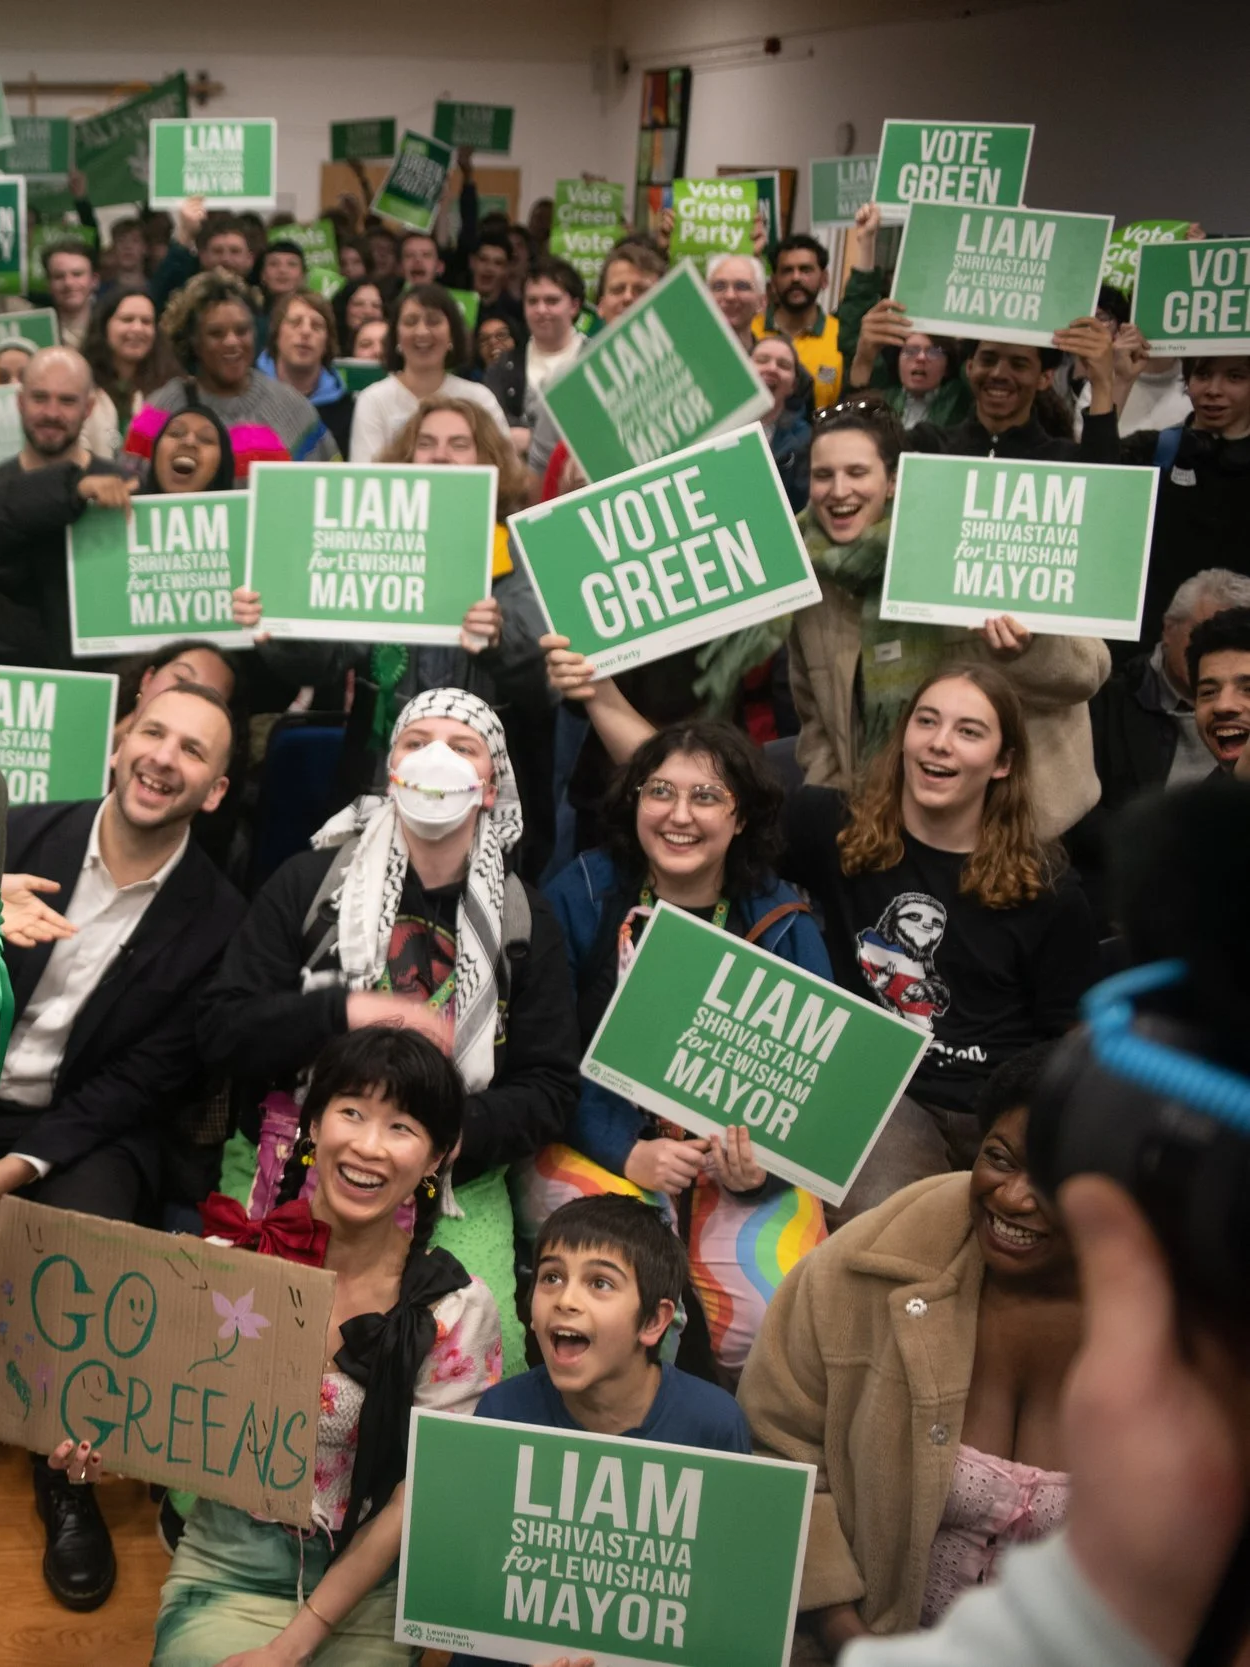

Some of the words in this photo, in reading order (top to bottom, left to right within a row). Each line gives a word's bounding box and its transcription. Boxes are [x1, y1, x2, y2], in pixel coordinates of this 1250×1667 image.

[183, 125, 245, 151] LIAM
[920, 129, 993, 166] VOTE
[182, 171, 245, 194] MAYOR
[566, 184, 613, 205] Vote
[688, 181, 744, 200] Vote
[897, 163, 1002, 205] GREEN
[557, 203, 617, 225] Green
[678, 197, 751, 222] Green
[563, 231, 615, 252] Vote
[680, 221, 744, 250] Party
[955, 213, 1057, 261] LIAM
[1123, 224, 1175, 243] Vote
[946, 268, 972, 287] for
[971, 272, 1046, 293] LEWISHAM
[953, 253, 1047, 277] SHRIVASTAVA
[1189, 247, 1250, 288] VOT
[943, 285, 1042, 322] MAYOR
[583, 306, 675, 407] LIAM
[624, 385, 714, 467] MAYOR
[313, 476, 431, 532] LIAM
[577, 465, 718, 562] VOTE
[963, 469, 1087, 525] LIAM
[127, 504, 231, 553] LIAM
[312, 530, 426, 552] SHRIVASTAVA
[960, 520, 1079, 545] SHRIVASTAVA
[128, 551, 230, 573] SHRIVASTAVA
[307, 551, 337, 571] for
[337, 553, 426, 573] LEWISHAM
[953, 538, 985, 560] for
[985, 544, 1079, 567] LEWISHAM
[126, 574, 151, 594] for
[151, 570, 231, 590] LEWISHAM
[309, 572, 426, 613] MAYOR
[580, 519, 767, 639] GREEN
[953, 561, 1076, 604] MAYOR
[129, 589, 233, 626] MAYOR
[596, 658, 617, 669] reen
[702, 951, 852, 1063] LIAM
[692, 1005, 819, 1085] SHRIVASTAVA
[676, 1027, 715, 1054] for
[711, 1038, 812, 1105] LEWISHAM
[663, 1048, 800, 1142] MAYOR
[30, 1254, 158, 1359] GO
[60, 1359, 308, 1491] GREENS
[513, 1444, 704, 1541] LIAM
[510, 1517, 693, 1570] SHRIVASTAVA
[501, 1546, 547, 1573] for
[549, 1553, 691, 1598] LEWISHAM
[503, 1574, 688, 1649] MAYOR
[425, 1634, 451, 1646] Green
[452, 1639, 475, 1651] Party
[426, 1627, 469, 1640] Lewisham
